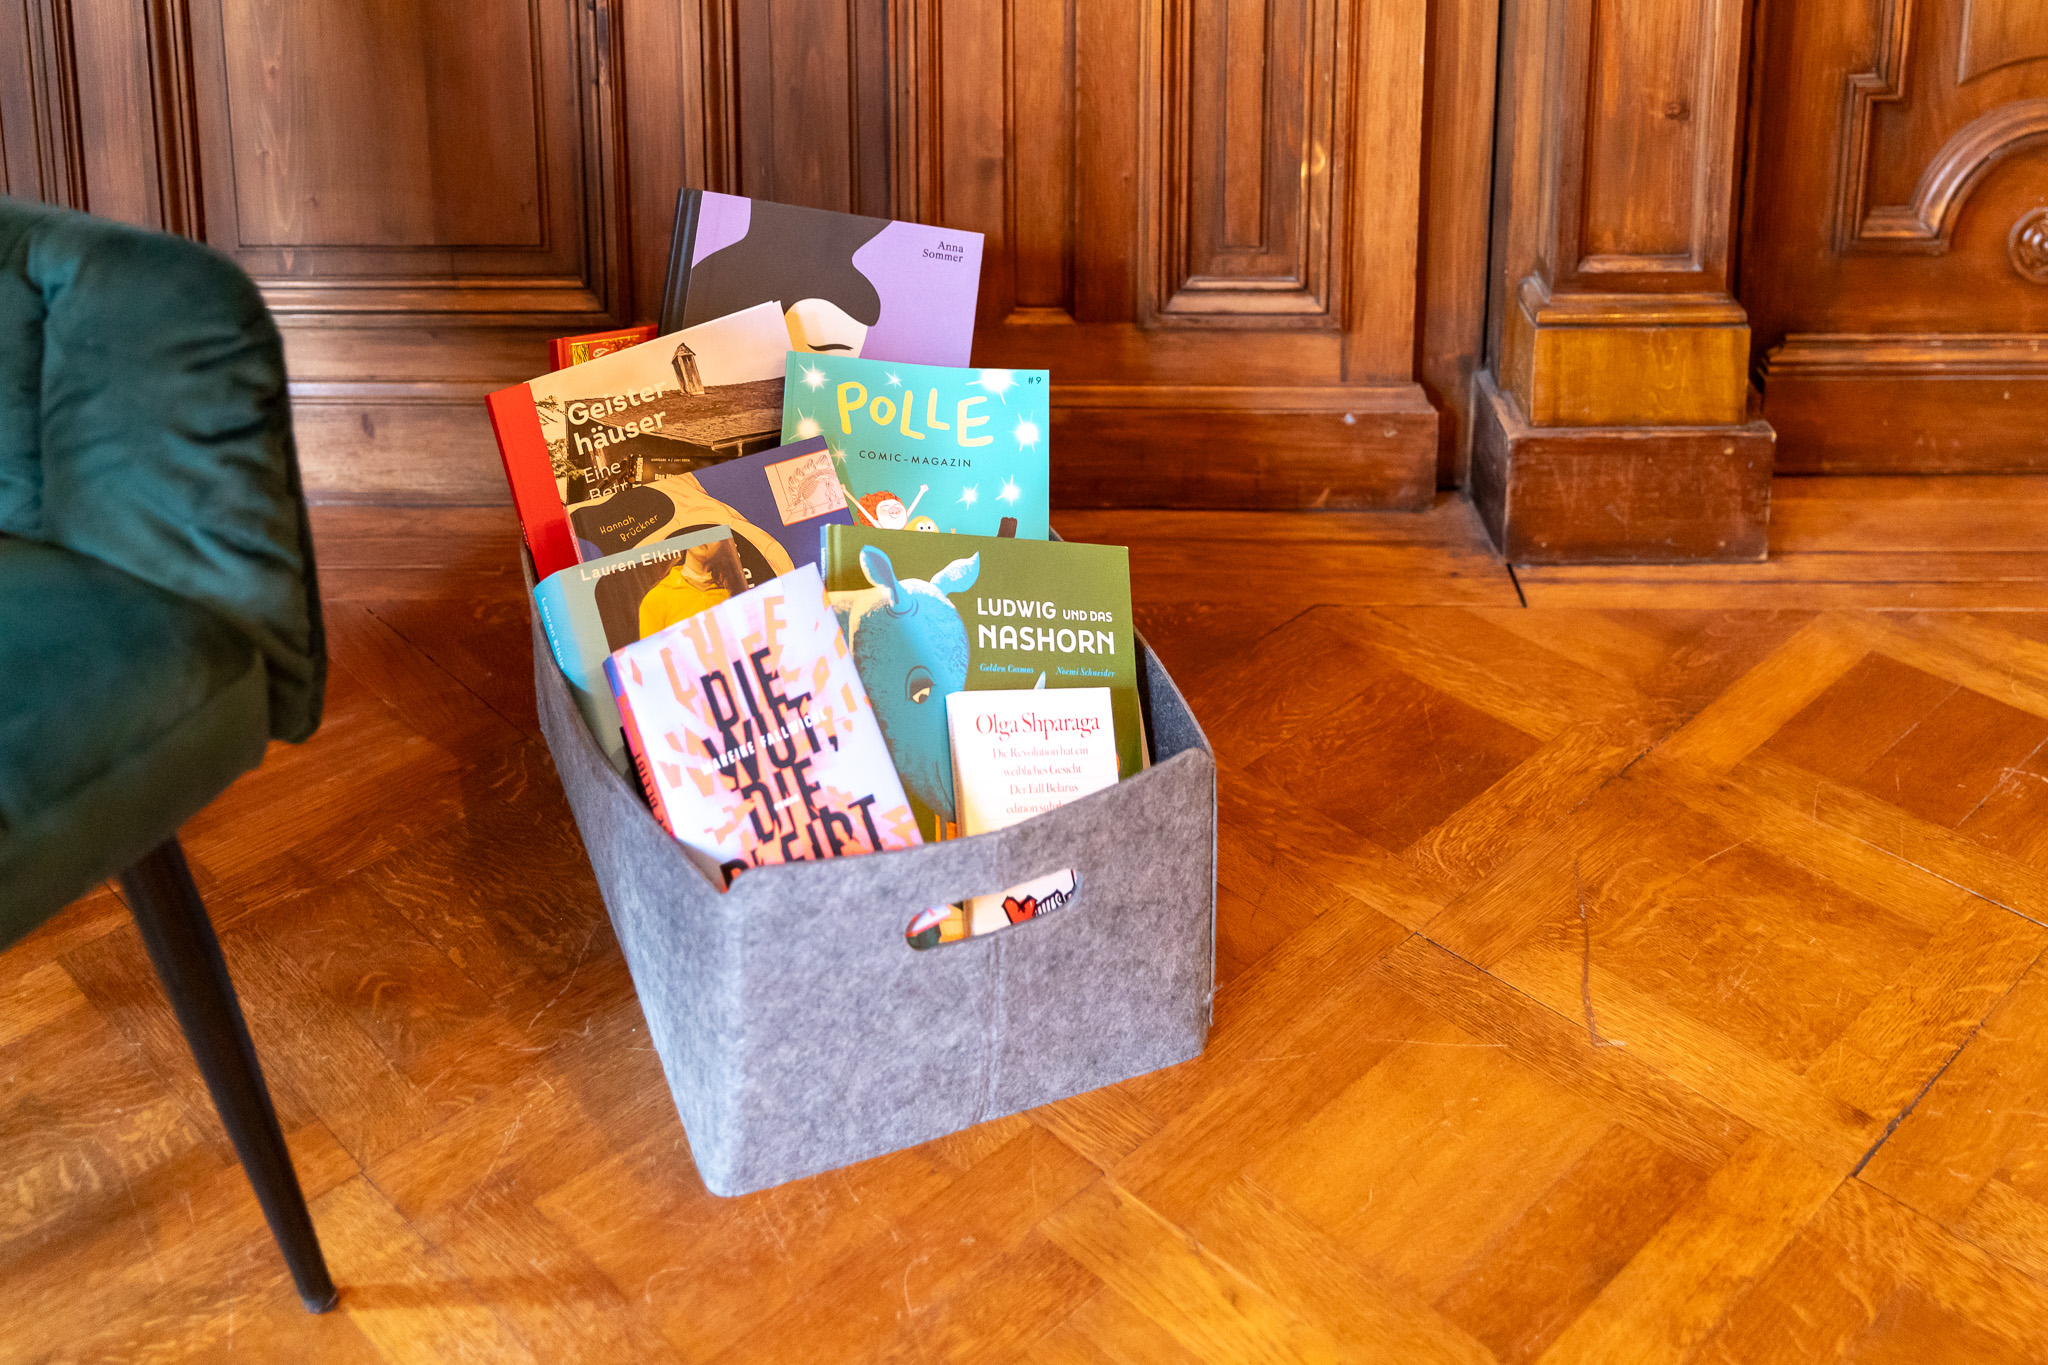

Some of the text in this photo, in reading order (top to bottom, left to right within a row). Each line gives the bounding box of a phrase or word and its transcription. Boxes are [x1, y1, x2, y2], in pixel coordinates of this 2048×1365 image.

[922, 248, 964, 263] Sommer
[937, 240, 964, 253] Anna
[567, 381, 666, 426] Geister
[573, 411, 666, 456] häuser
[583, 459, 622, 484] Eine
[599, 515, 636, 535] Hannah
[619, 513, 659, 543] Brückner
[580, 547, 682, 582] Lauren Elkin
[977, 597, 1113, 623] LUDWIG UND DAS
[541, 597, 565, 669] Lauren Elkin
[978, 624, 1116, 655] NASHORN
[979, 662, 1034, 674] Golden Cosmos
[1055, 666, 1116, 677] Noemi Schneider
[975, 712, 1100, 741] Olga Shparaga
[992, 745, 1089, 759] Die Revolution hat ein
[1003, 763, 1082, 777] weibliches Gesicht
[1009, 782, 1079, 795] Der Fall Belarus
[1006, 802, 1038, 815] edition
